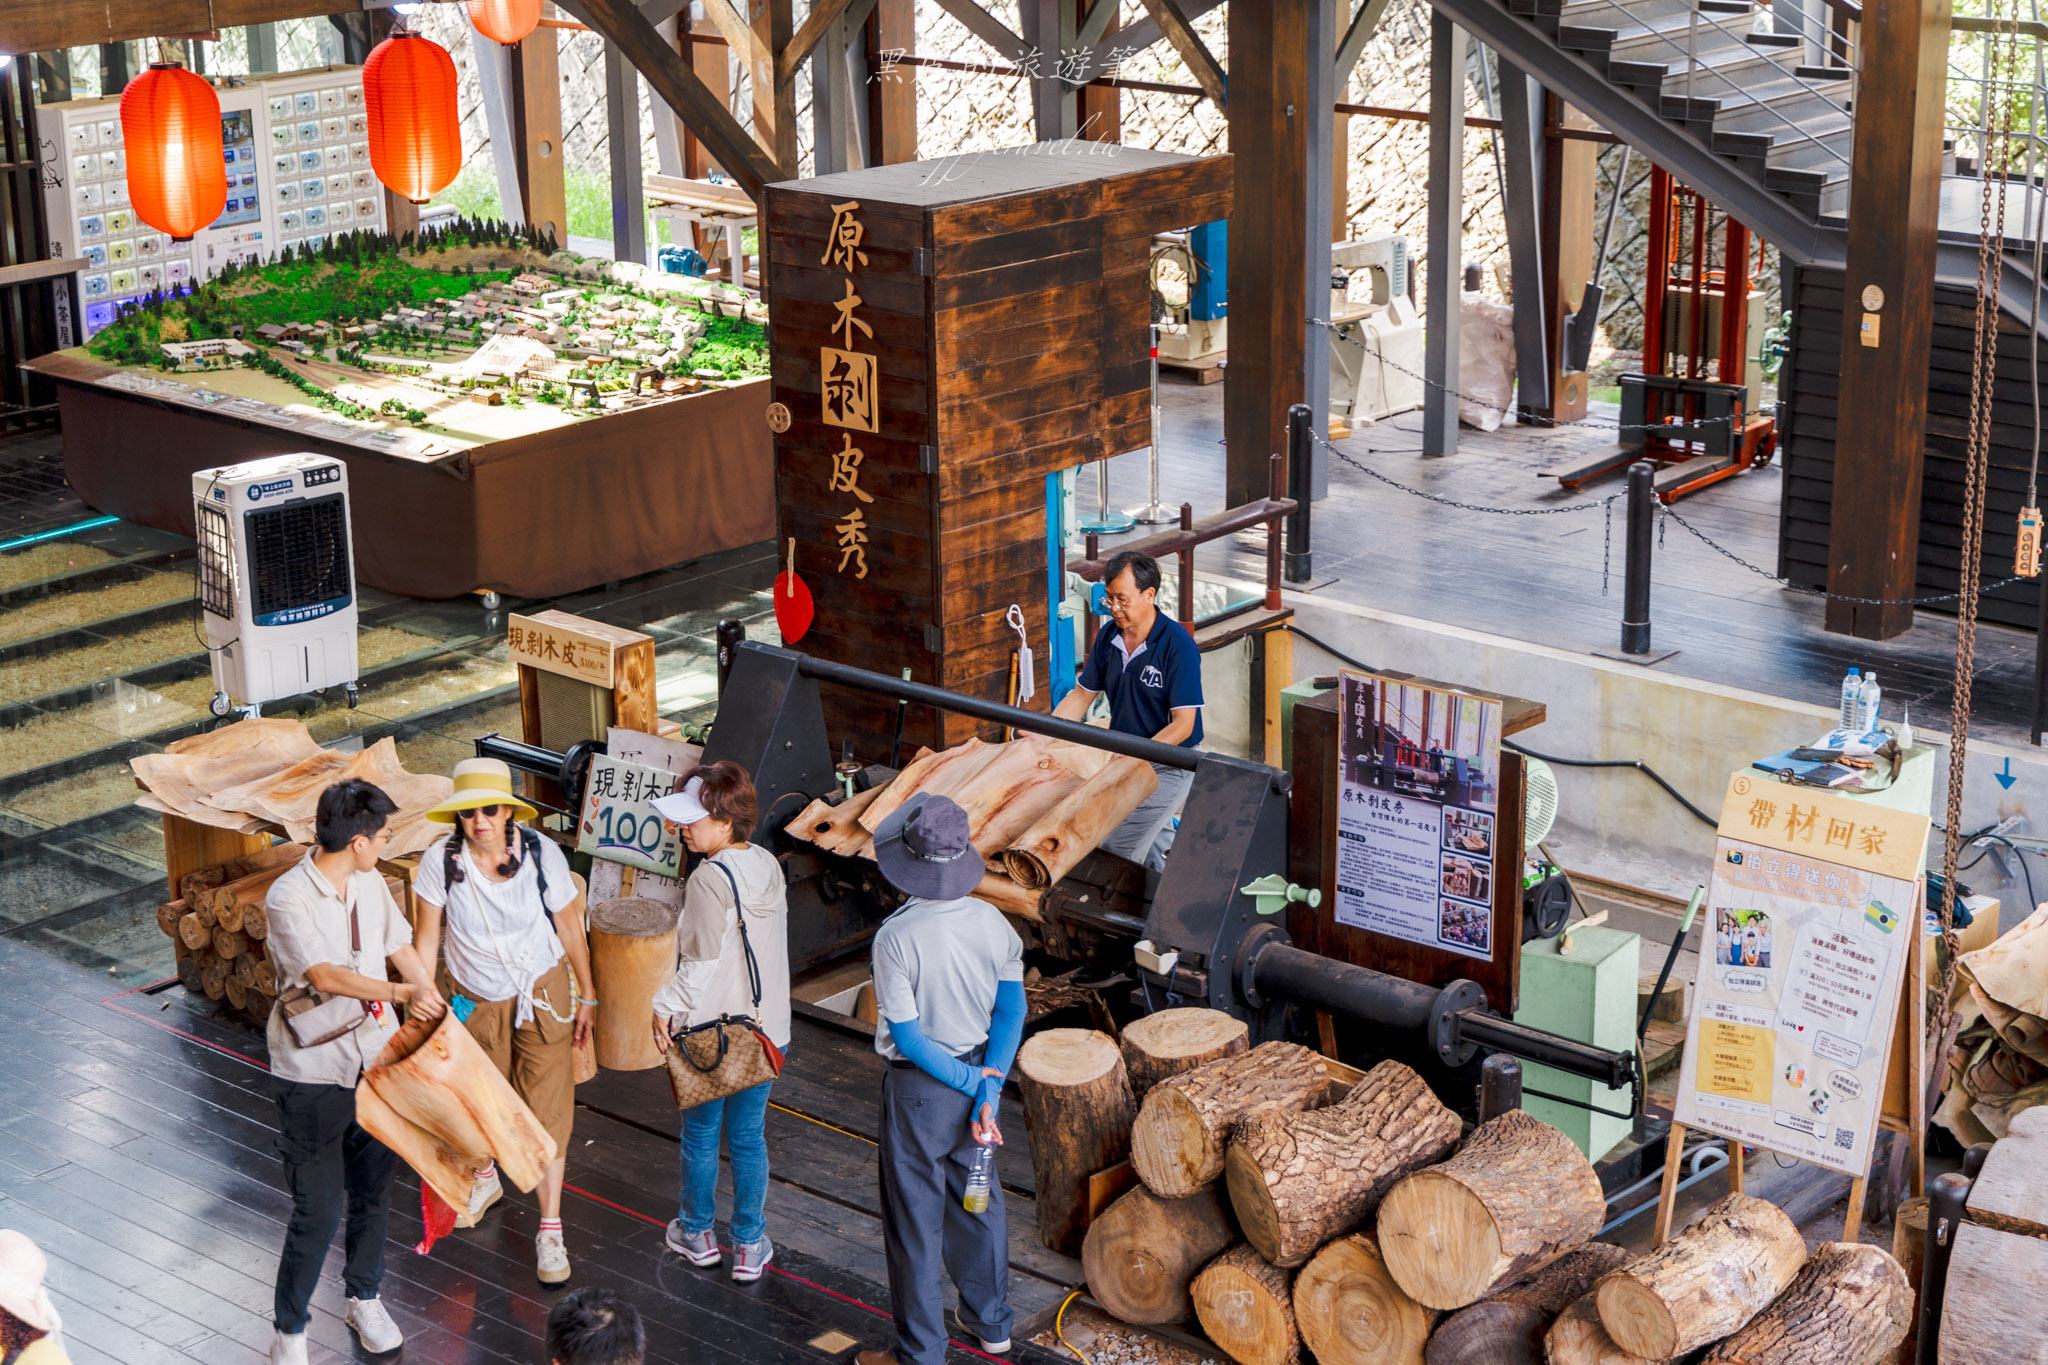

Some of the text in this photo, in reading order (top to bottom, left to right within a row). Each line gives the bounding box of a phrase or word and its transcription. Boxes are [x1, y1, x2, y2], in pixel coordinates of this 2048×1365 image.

[821, 200, 877, 580] 原木剝皮秀
[508, 627, 578, 669] 現剝木皮
[1343, 788, 1405, 815] 原木剝皮秀
[598, 806, 661, 852] 100
[1749, 798, 1888, 856] 帶材回家
[659, 843, 676, 867] 元
